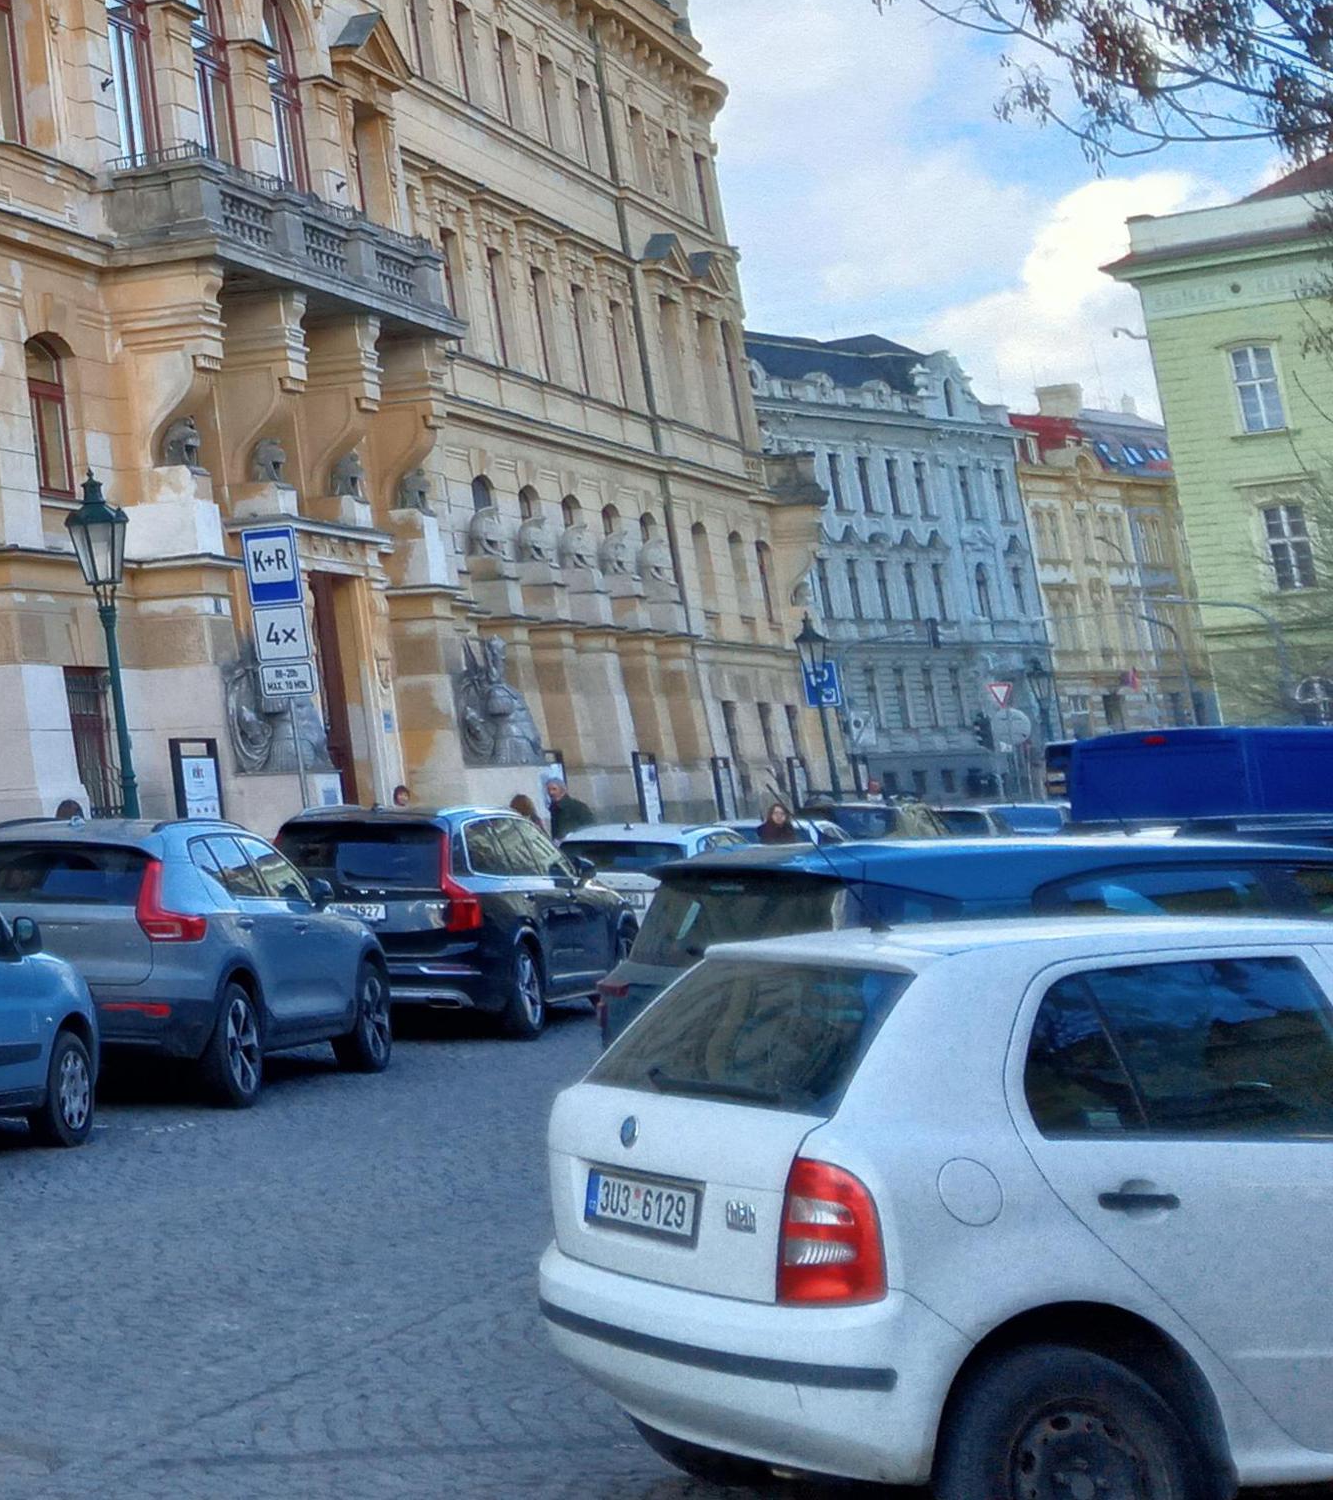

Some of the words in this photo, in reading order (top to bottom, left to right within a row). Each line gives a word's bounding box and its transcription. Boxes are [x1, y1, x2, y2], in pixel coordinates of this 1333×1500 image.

[253, 548, 288, 573] K+R
[599, 1180, 631, 1217] 3U3
[641, 1190, 686, 1230] 6129
